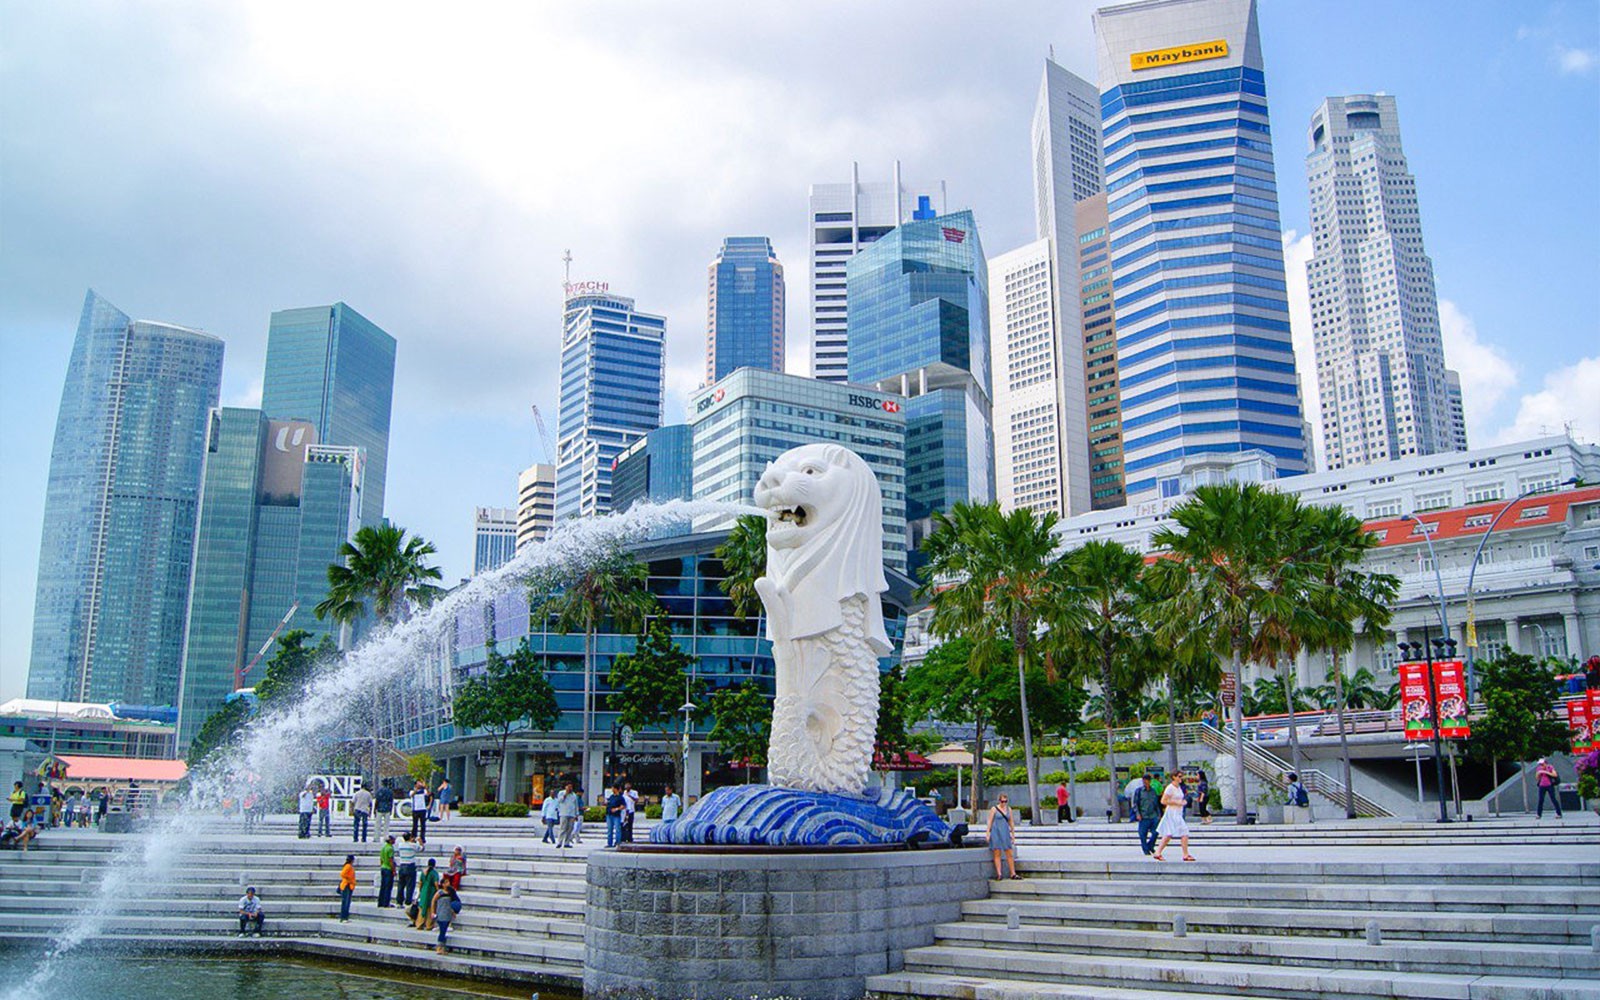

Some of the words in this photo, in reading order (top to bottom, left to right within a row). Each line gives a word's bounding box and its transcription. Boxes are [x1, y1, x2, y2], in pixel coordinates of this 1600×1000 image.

[1146, 45, 1224, 63] Maybank
[848, 394, 882, 410] HSBC
[633, 753, 660, 764] Coffee
[305, 775, 363, 798] ONE
